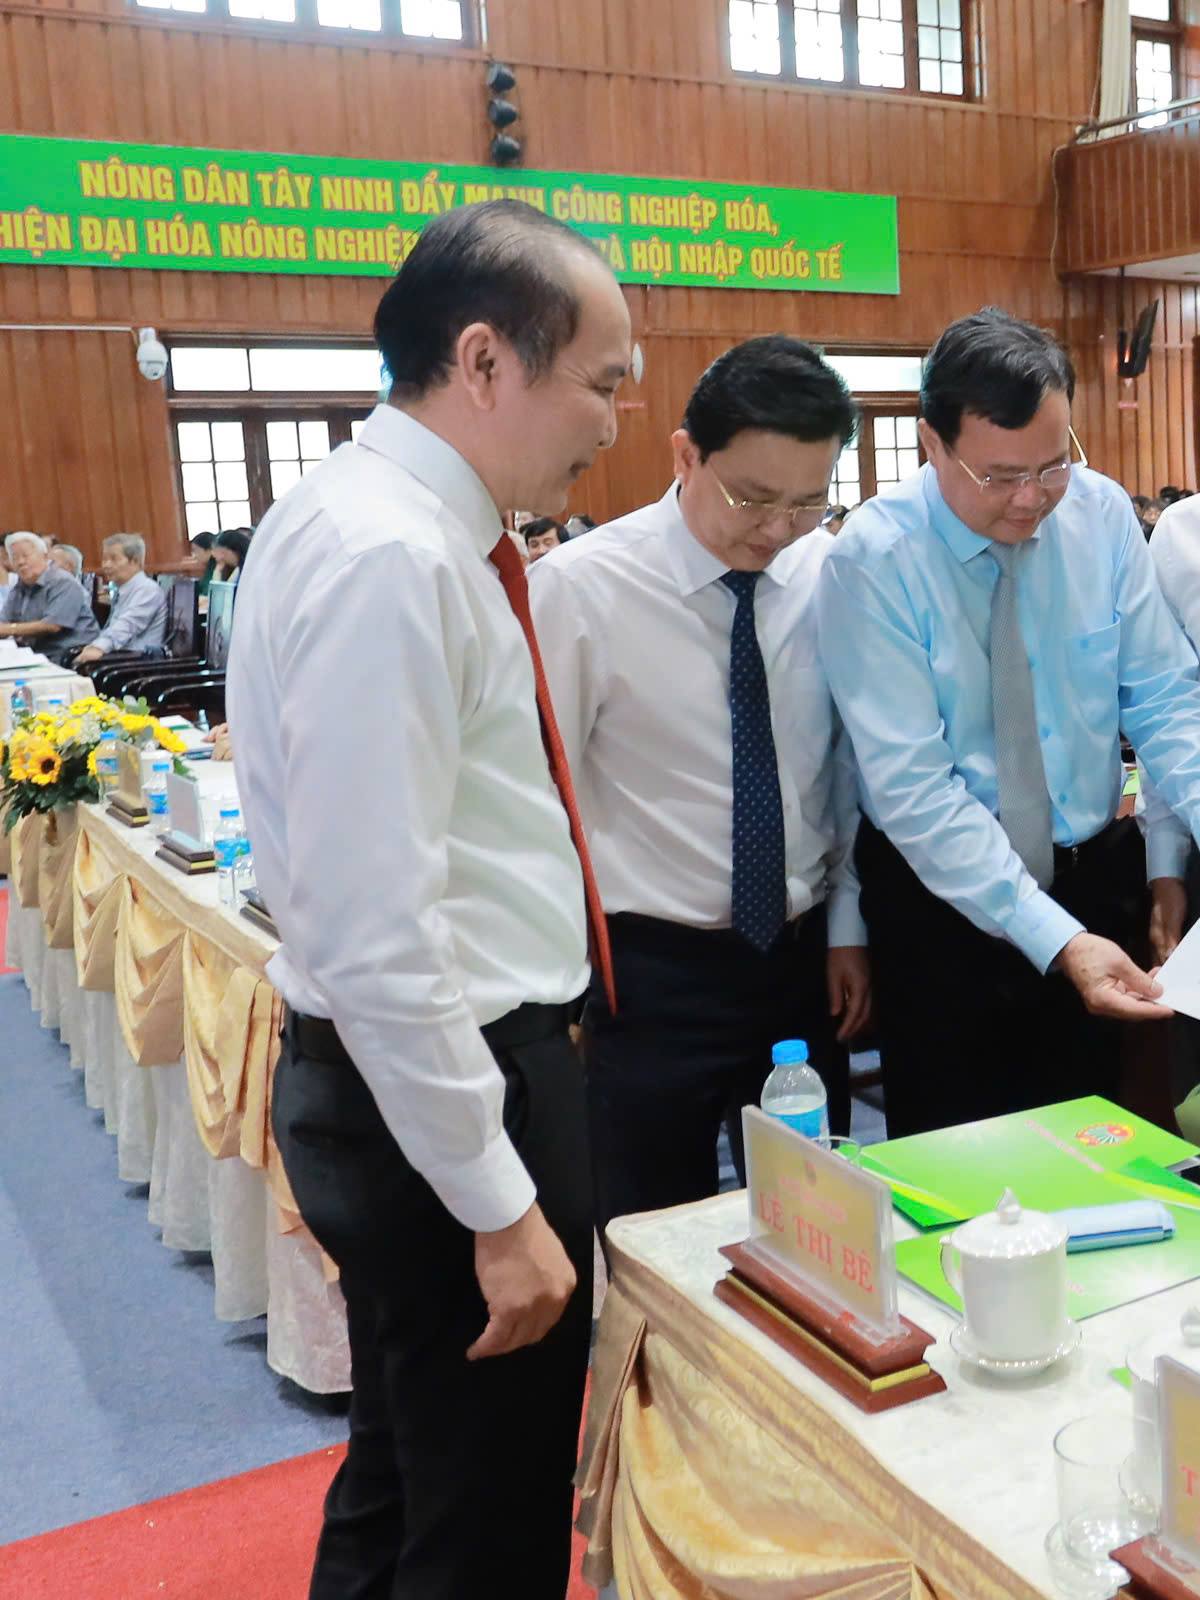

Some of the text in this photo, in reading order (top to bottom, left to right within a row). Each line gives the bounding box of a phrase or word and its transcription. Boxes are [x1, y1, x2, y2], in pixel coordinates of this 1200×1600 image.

[78, 155, 176, 201] NÔNG
[182, 161, 250, 206] DÂN
[256, 167, 312, 209] TÂY
[319, 175, 395, 213] NINH
[552, 184, 623, 225] CÔNG
[629, 192, 718, 235] NGHIỆP
[724, 196, 780, 236] HÓA,
[78, 214, 139, 261] ĐẠI
[144, 212, 213, 257] HÓA
[219, 216, 308, 261] NÔNG
[630, 235, 673, 280] HỘI
[679, 239, 743, 282] NHẬP
[750, 239, 811, 281] QUỐC
[815, 242, 843, 280] TẾ
